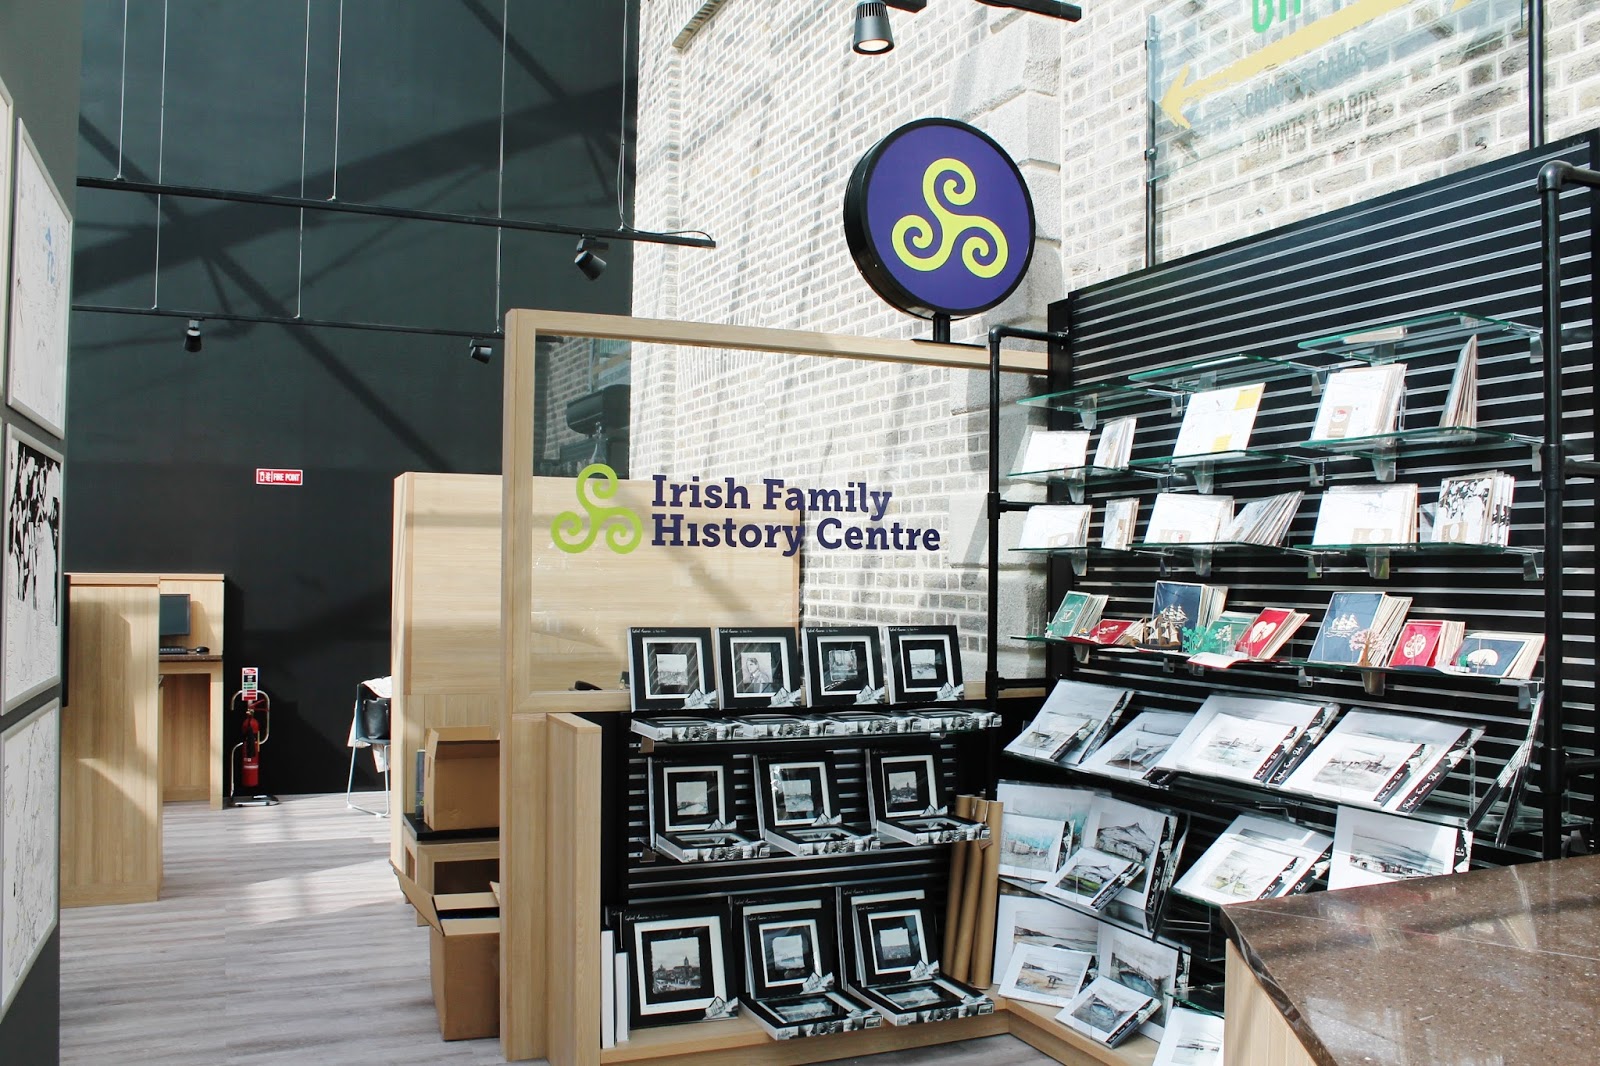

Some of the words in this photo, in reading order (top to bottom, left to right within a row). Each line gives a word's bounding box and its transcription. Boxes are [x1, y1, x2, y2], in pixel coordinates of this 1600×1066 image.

[1316, 41, 1370, 87] CARDS
[273, 473, 284, 481] FIRE
[285, 473, 300, 482] POINT
[652, 475, 750, 509] Irish
[762, 478, 892, 521] Family
[652, 514, 806, 557] History
[816, 518, 941, 551] Centre
